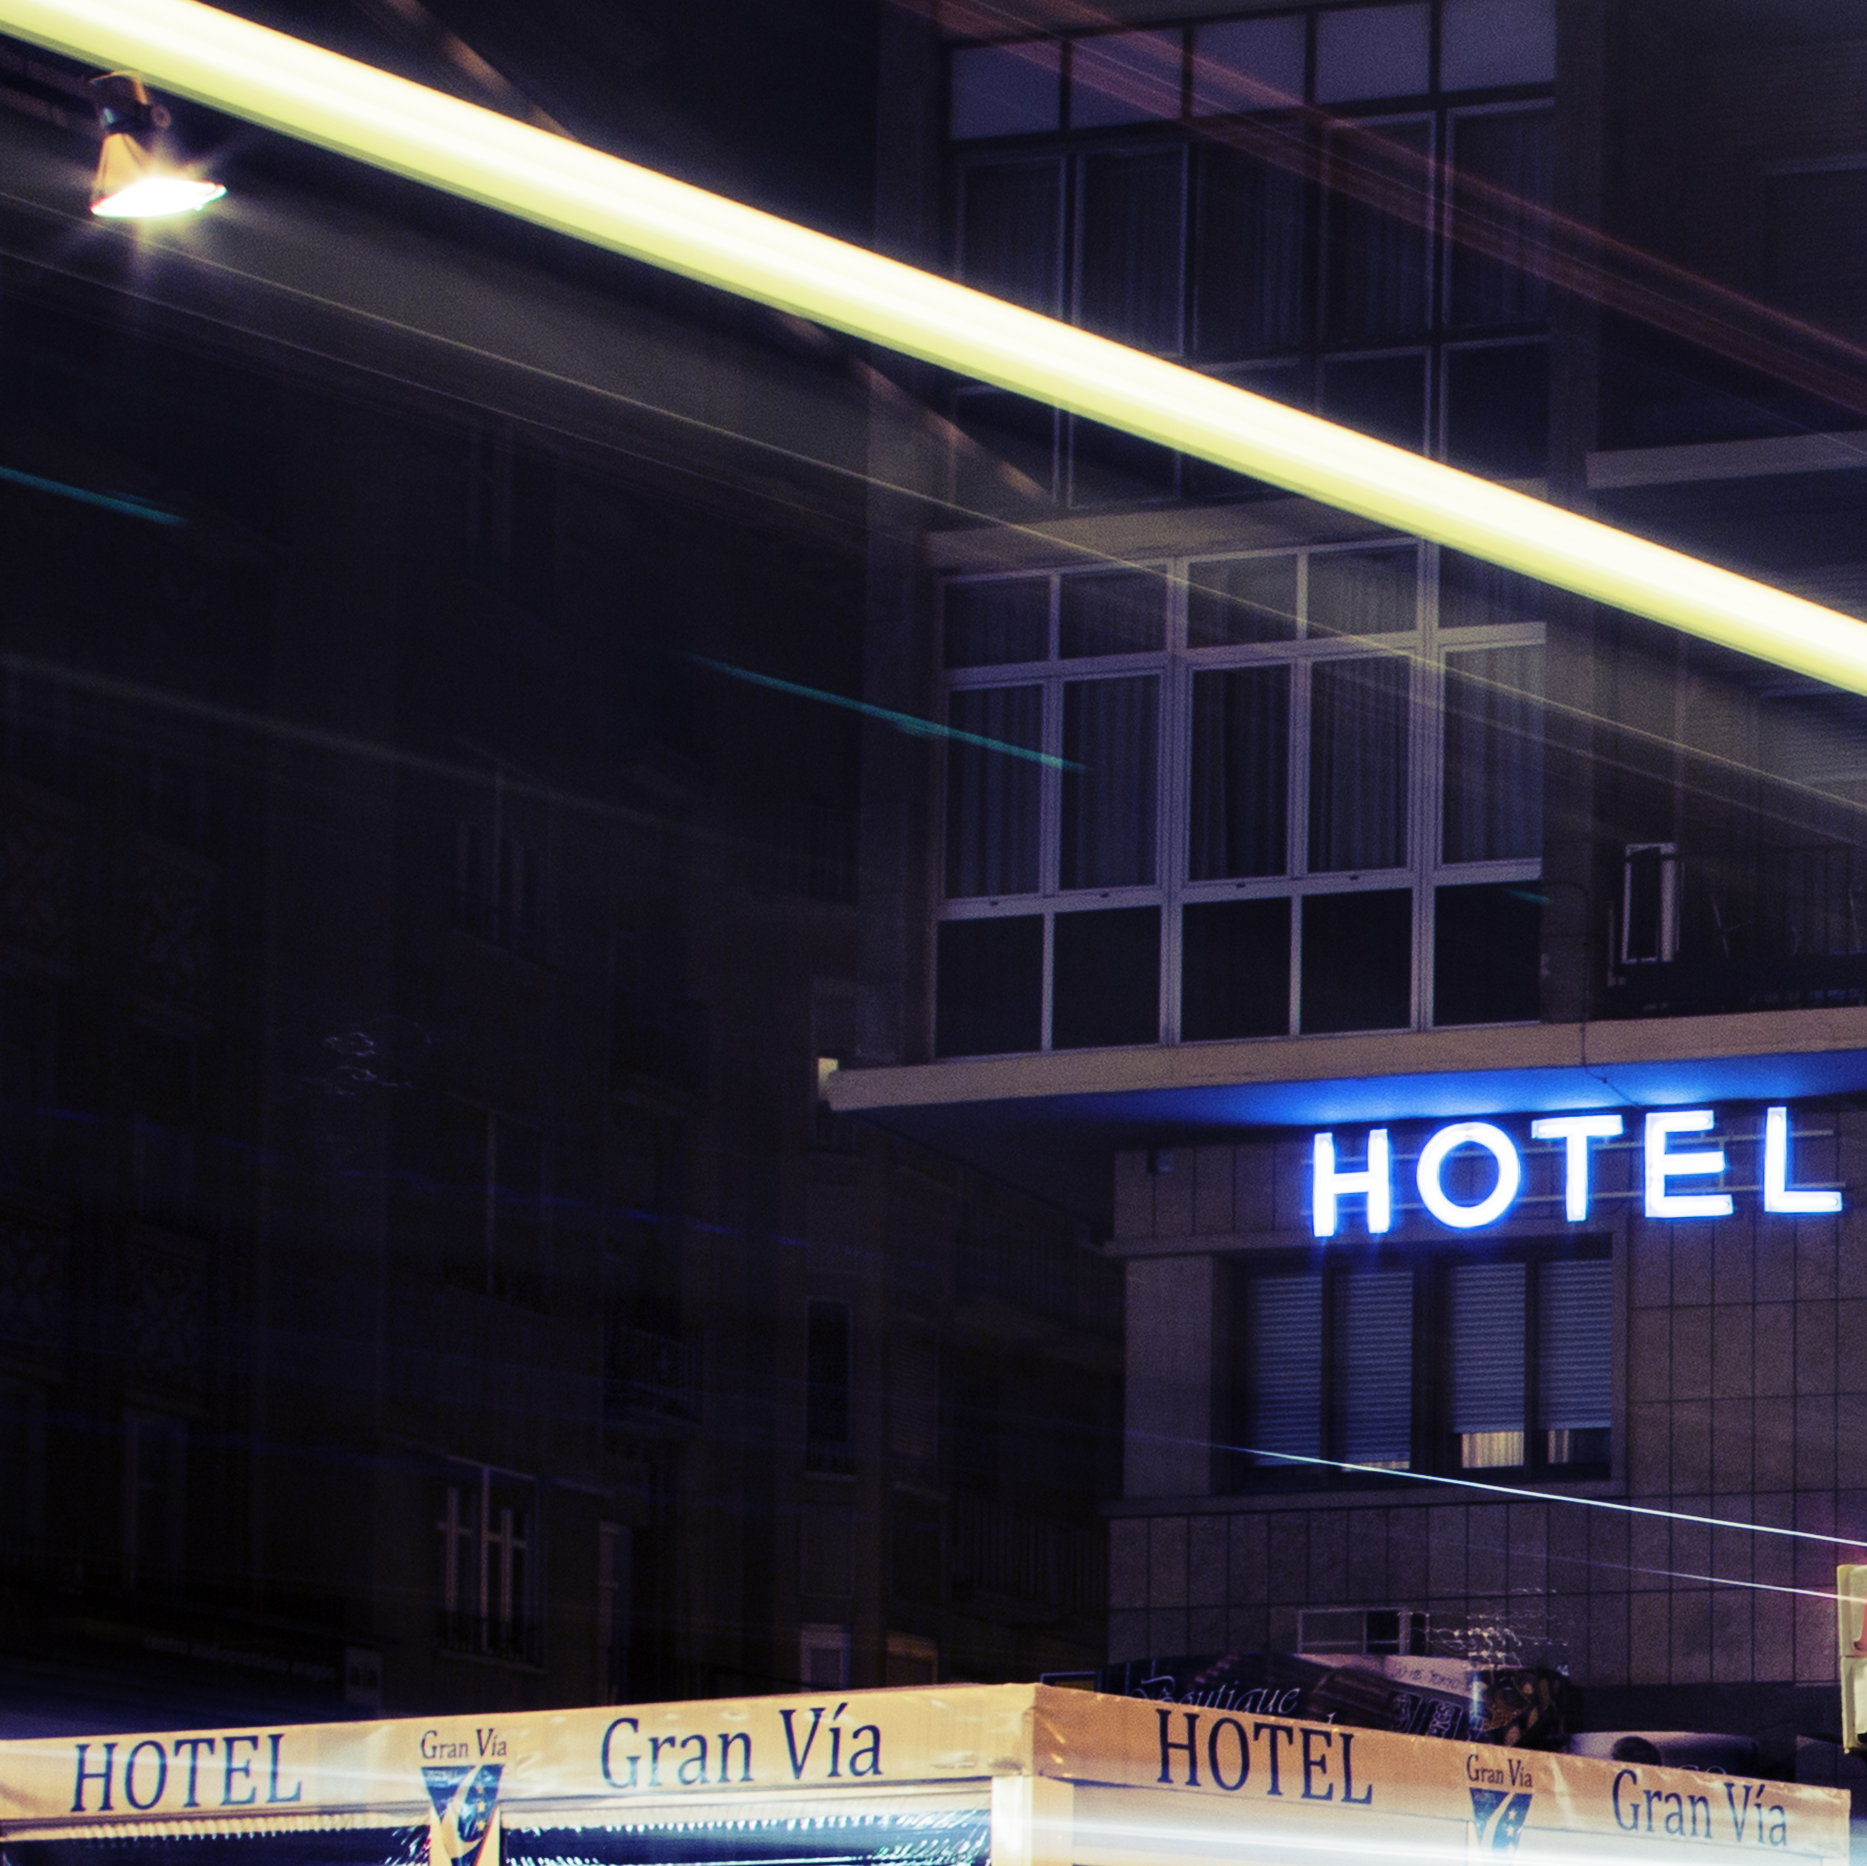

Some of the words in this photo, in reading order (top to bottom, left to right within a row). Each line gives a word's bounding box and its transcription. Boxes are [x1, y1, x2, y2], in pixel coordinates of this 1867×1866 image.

[1312, 1107, 1842, 1237] HOTEL
[70, 1734, 302, 1812] HOTEL
[421, 1729, 469, 1759] Gran
[601, 1717, 754, 1789] Gran
[779, 1702, 882, 1780] Vía
[1156, 1709, 1373, 1805] HOTEL
[1466, 1754, 1504, 1784] Gran
[1612, 1769, 1712, 1839] Gran
[1724, 1783, 1788, 1846] Vía
